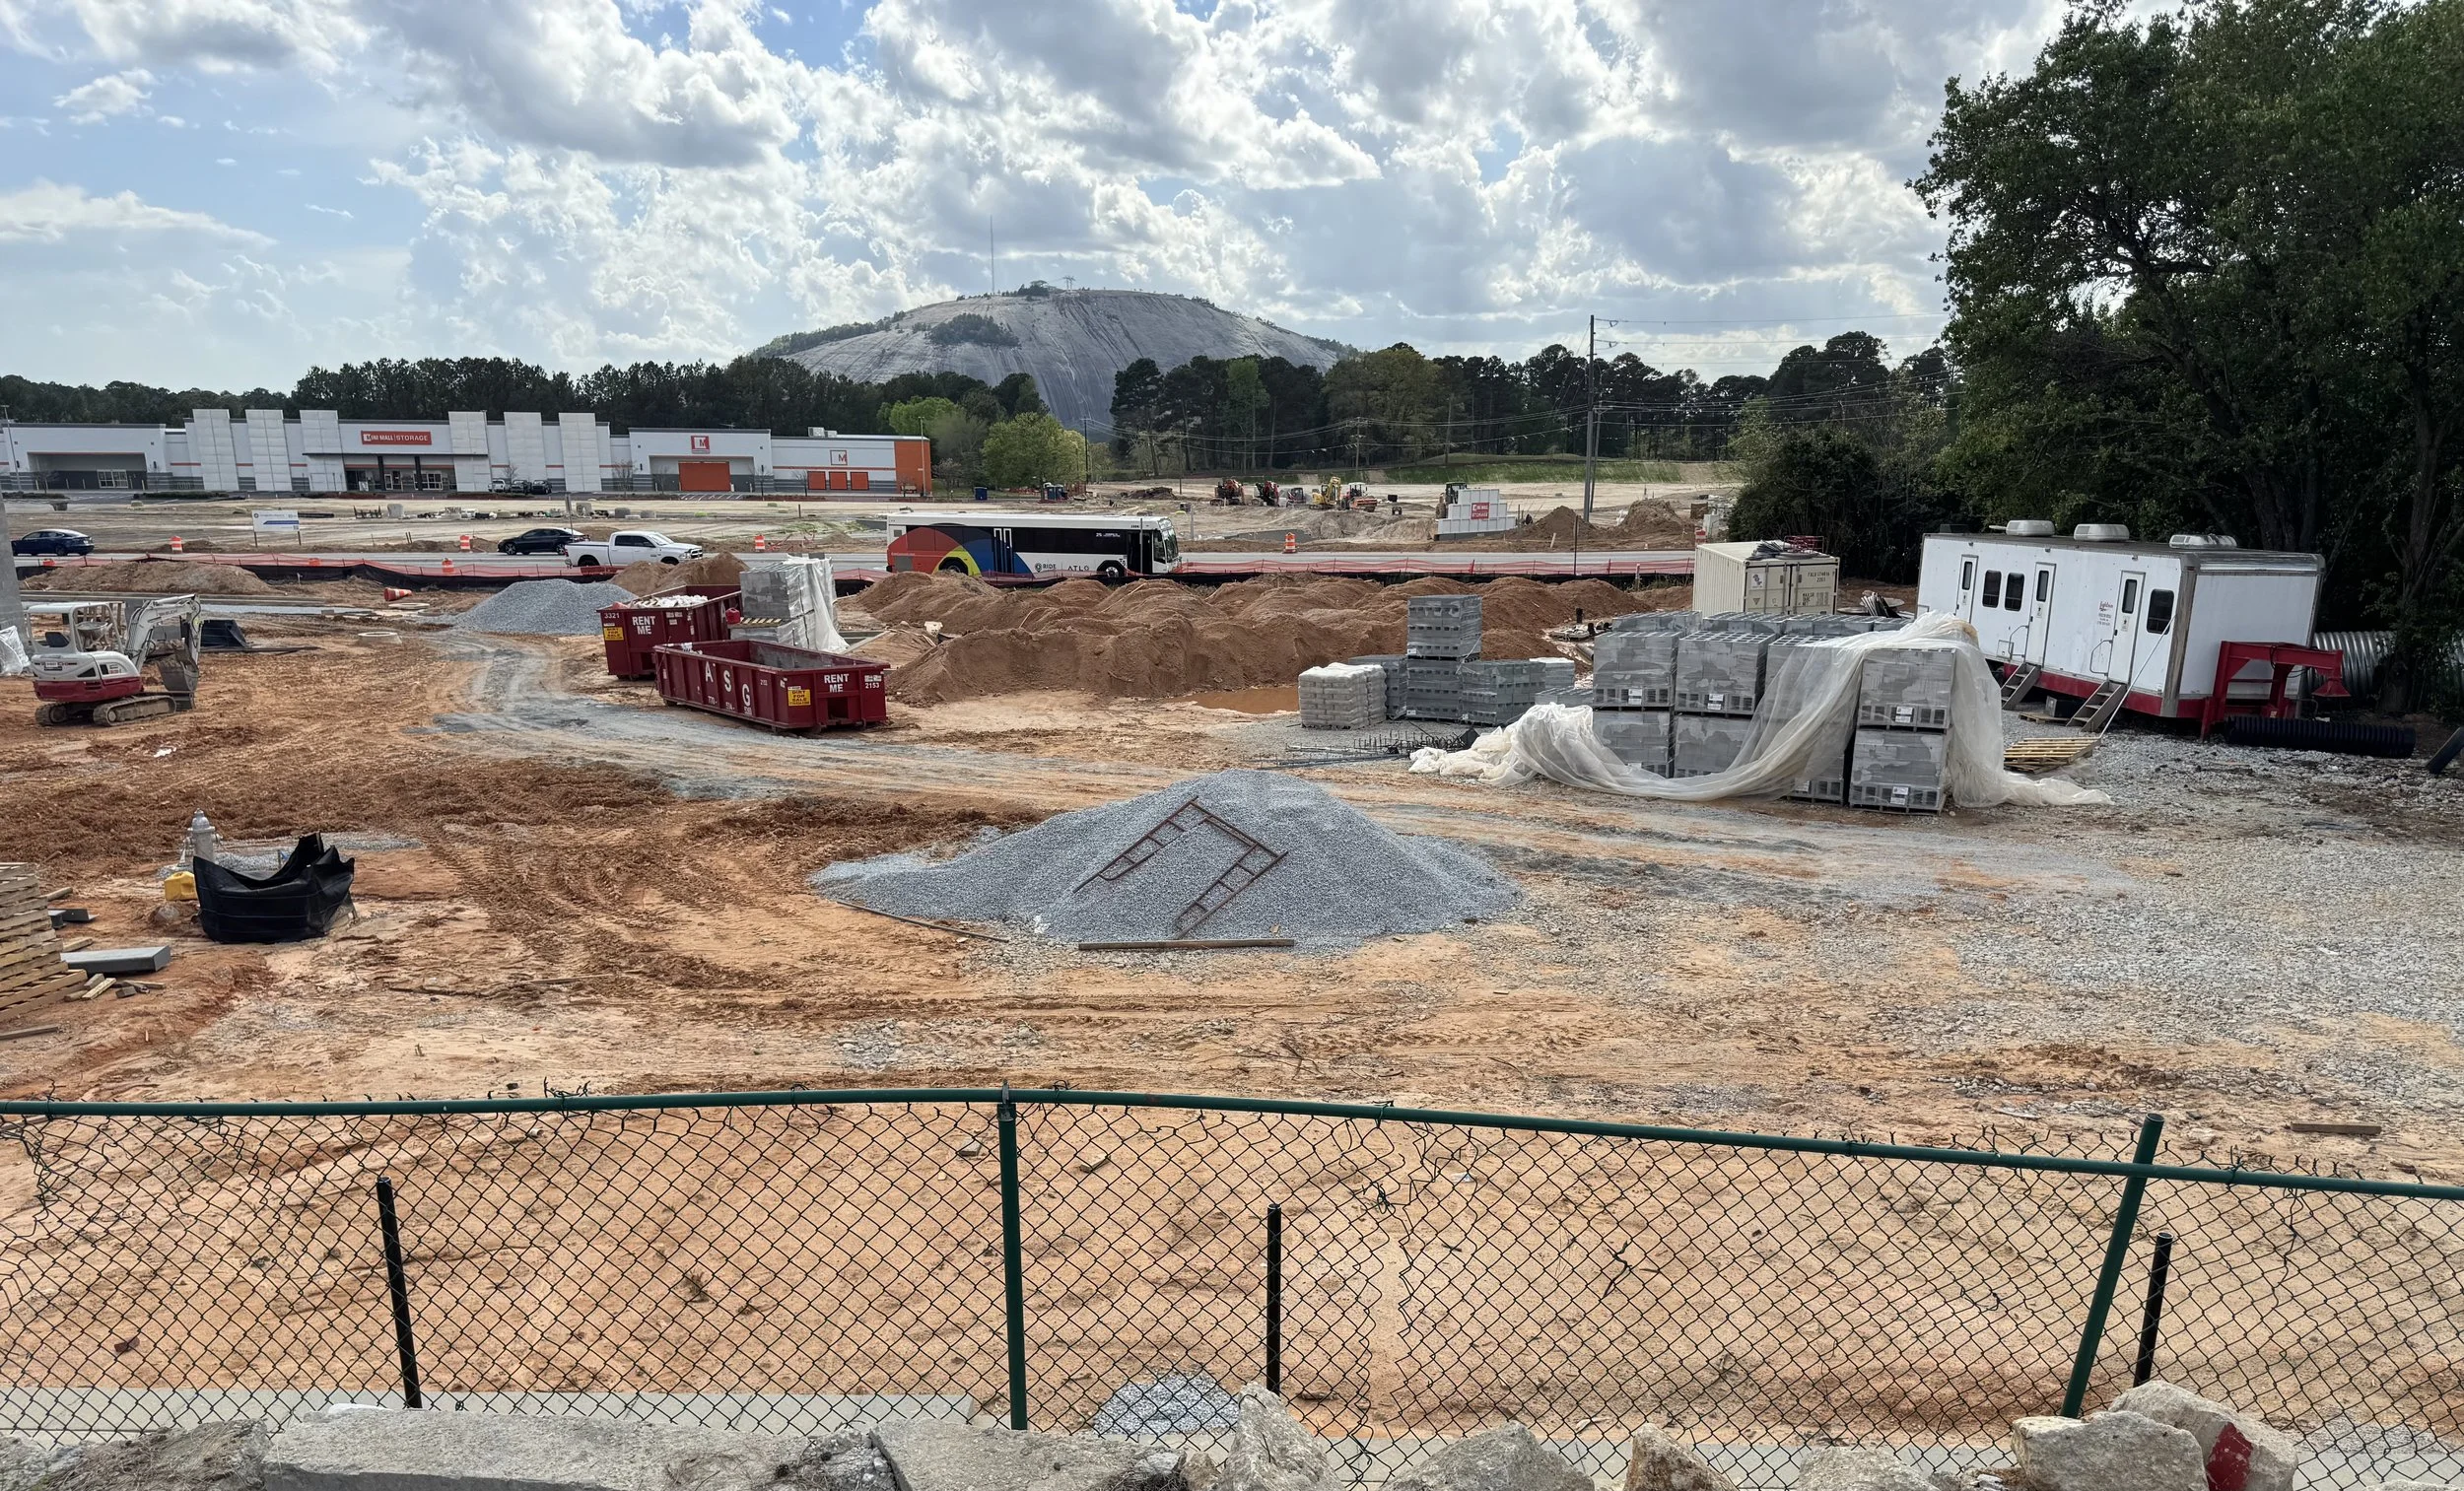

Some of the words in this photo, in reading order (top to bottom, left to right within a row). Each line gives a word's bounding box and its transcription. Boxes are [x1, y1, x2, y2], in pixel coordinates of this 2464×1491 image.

[632, 616, 656, 626] RENT
[637, 625, 652, 635] ME
[824, 674, 850, 684] RENT
[829, 684, 845, 693] ME
